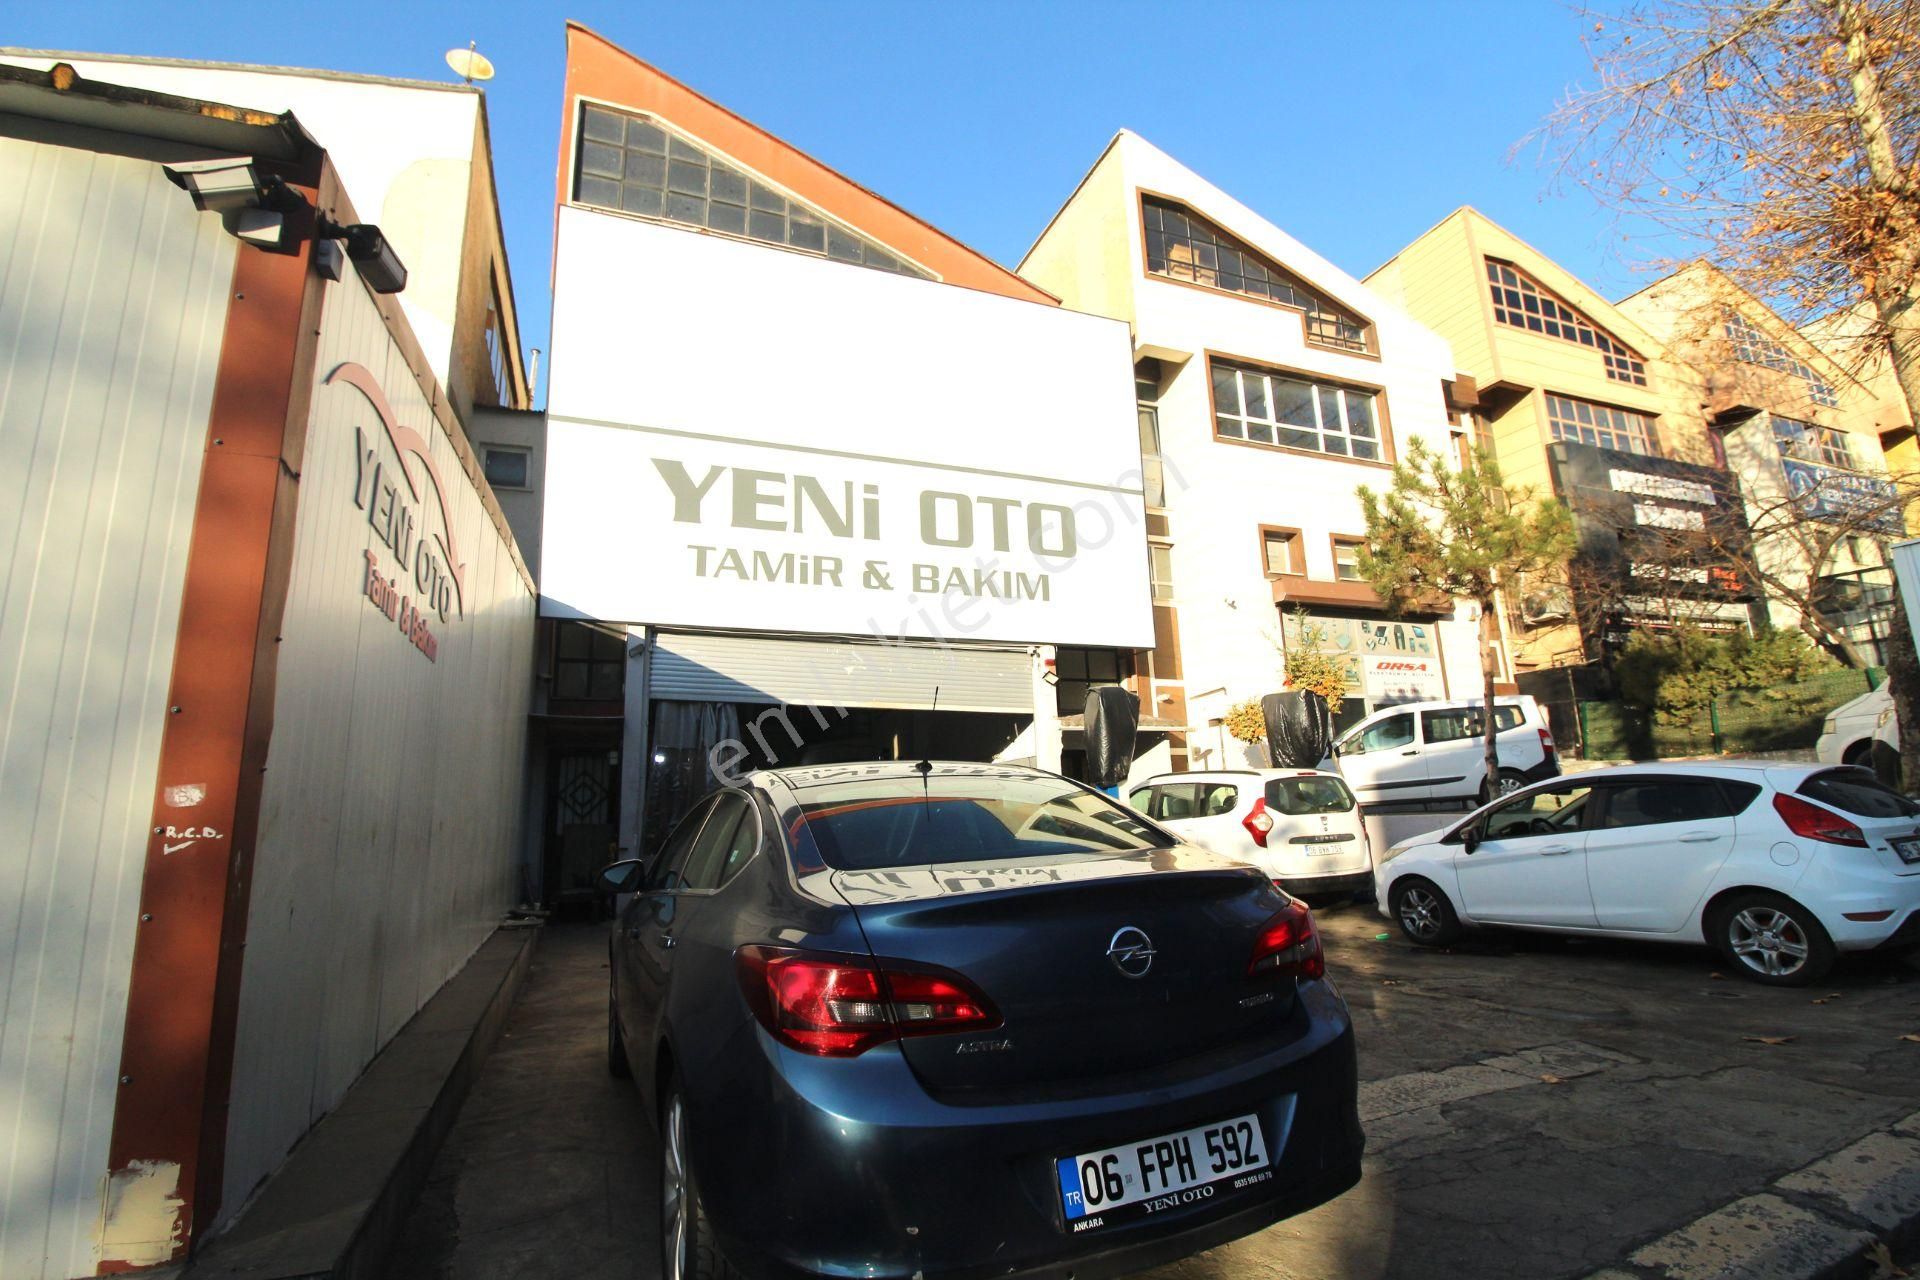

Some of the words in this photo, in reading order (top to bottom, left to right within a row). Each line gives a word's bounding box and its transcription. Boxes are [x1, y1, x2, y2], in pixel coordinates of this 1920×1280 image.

[919, 489, 1077, 558] OTO
[363, 549, 399, 622] Tamir
[399, 595, 411, 636] &
[416, 539, 452, 624] OTO
[862, 560, 894, 591] &
[912, 563, 1050, 602] BAKIM
[1377, 661, 1426, 672] ORSA
[1066, 1191, 1082, 1206] TR
[1081, 1154, 1125, 1206] 06
[1136, 1136, 1197, 1193] FPH
[1204, 1122, 1260, 1173] 592
[1182, 1185, 1214, 1204] OTO
[1073, 1216, 1104, 1233] ANKARA
